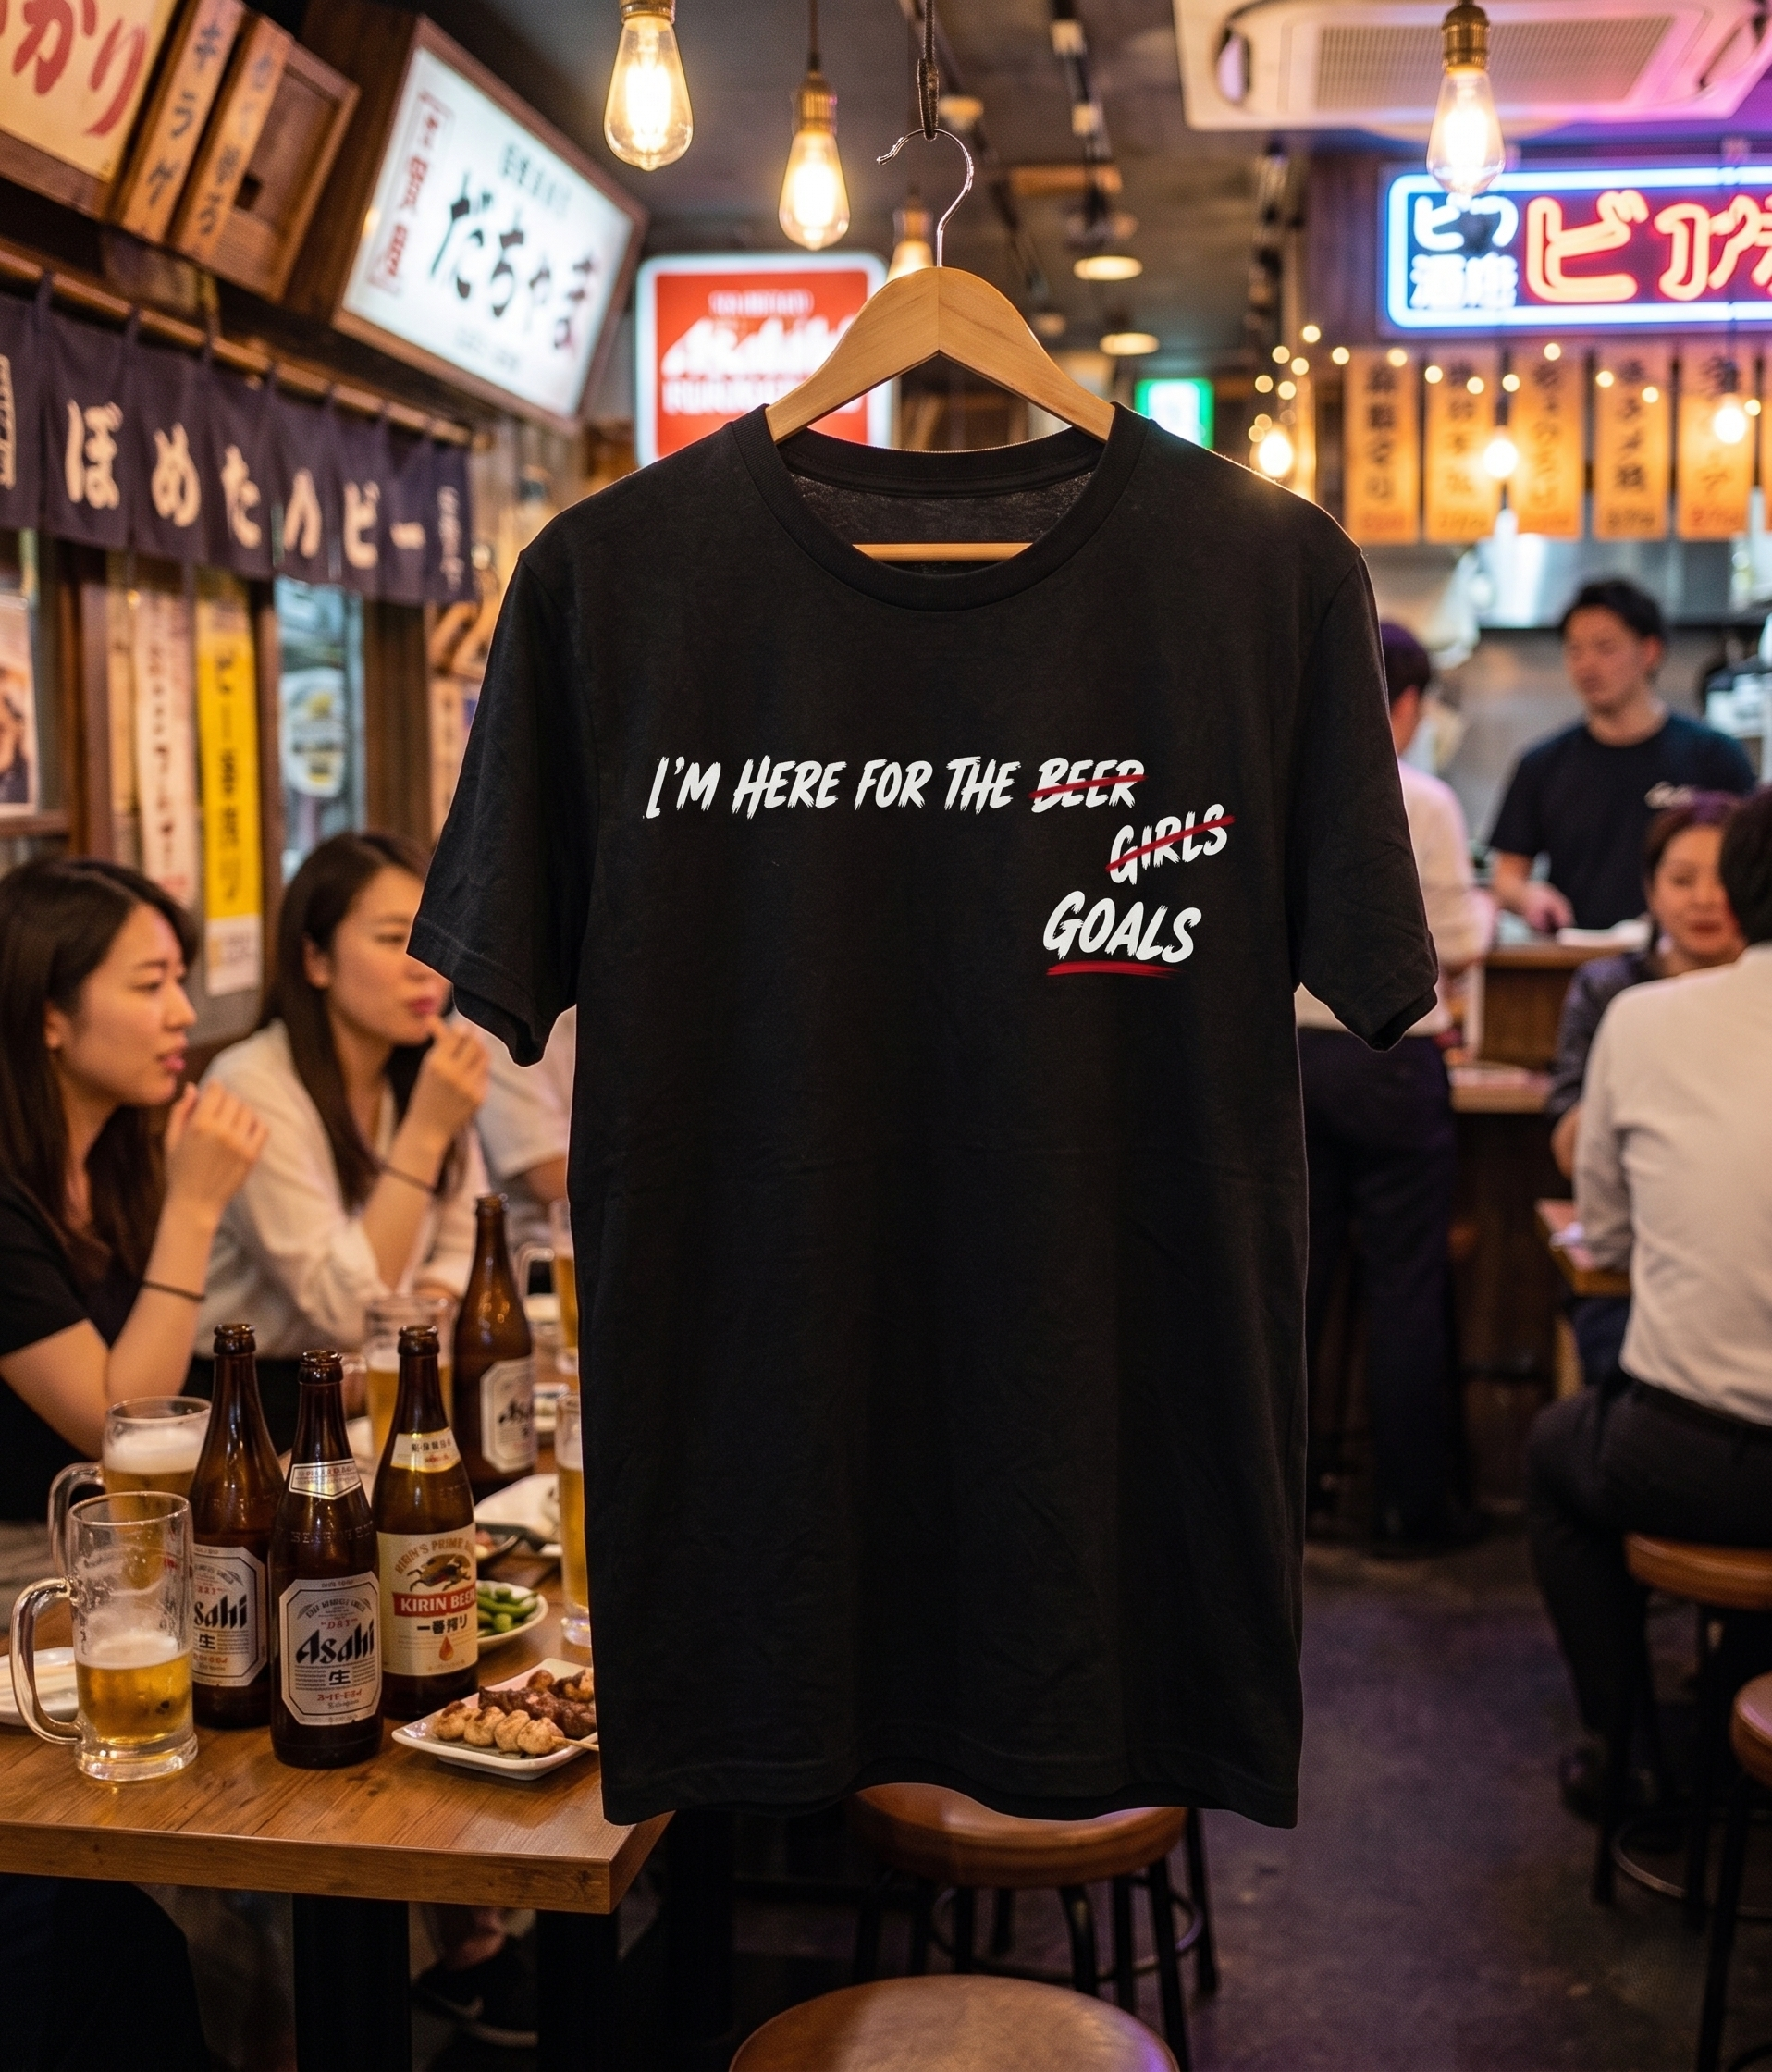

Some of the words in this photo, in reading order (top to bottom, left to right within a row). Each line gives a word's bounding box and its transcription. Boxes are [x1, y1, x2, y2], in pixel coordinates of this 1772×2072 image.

[643, 757, 721, 819] I'M
[732, 755, 846, 819] HERE
[855, 759, 932, 810] FOR
[944, 757, 1021, 814] THE
[1029, 758, 1145, 813] BEER
[1109, 803, 1230, 884] GIRLS
[1043, 891, 1201, 963] GOALS
[193, 1594, 248, 1629] sahi
[400, 1597, 447, 1612] KIRIN
[198, 1634, 215, 1650] 生
[296, 1619, 375, 1664] Asahi
[328, 1669, 351, 1686] 生
